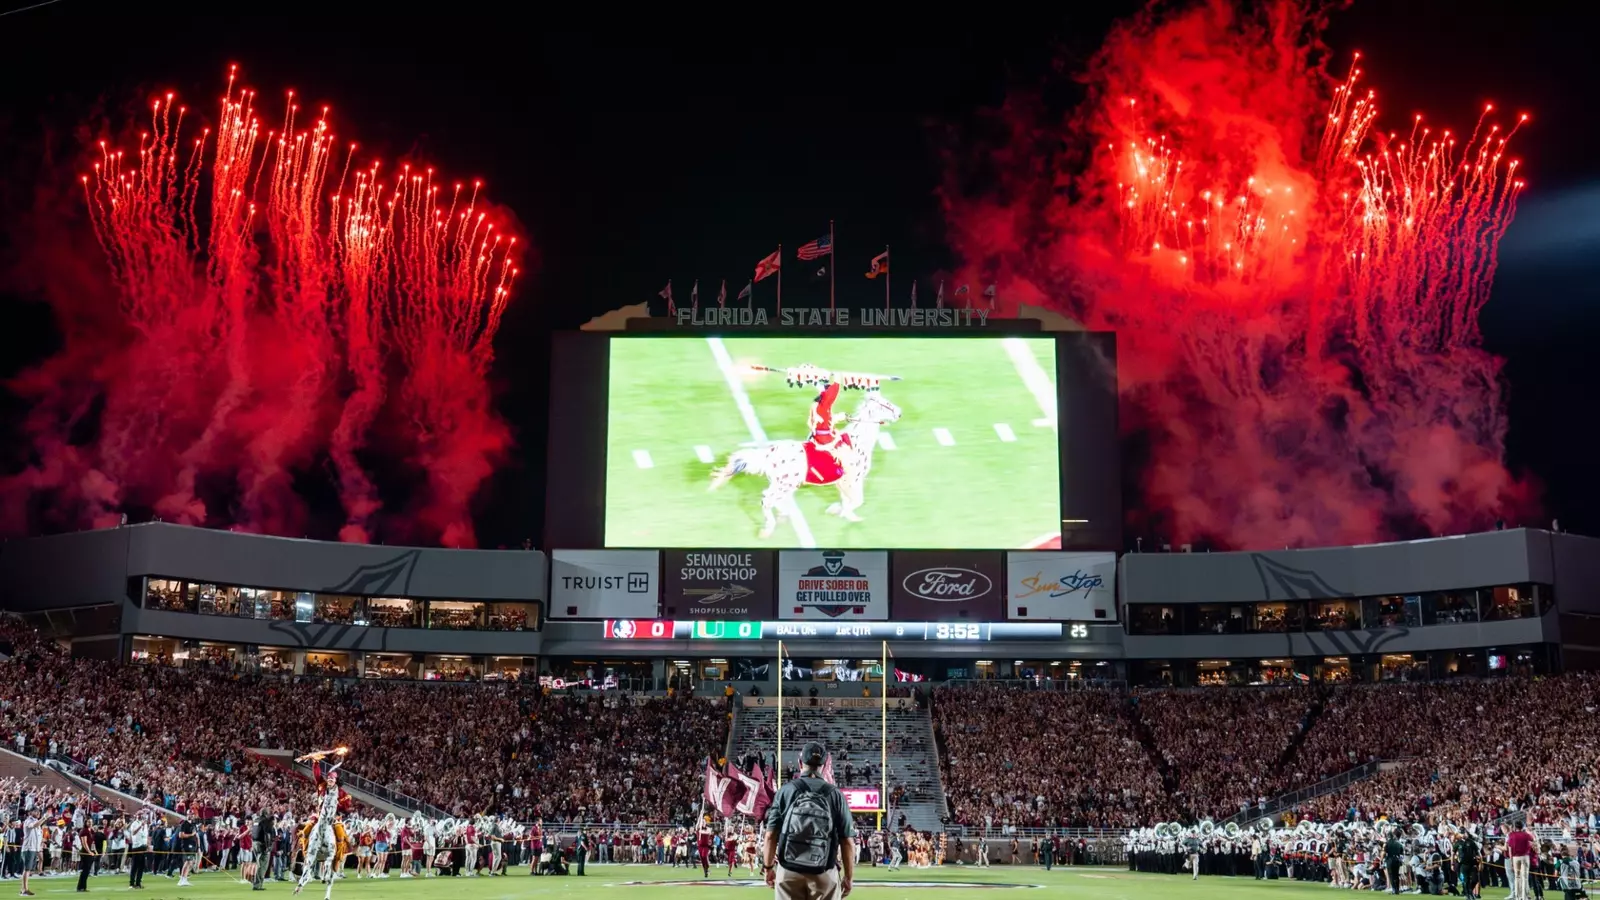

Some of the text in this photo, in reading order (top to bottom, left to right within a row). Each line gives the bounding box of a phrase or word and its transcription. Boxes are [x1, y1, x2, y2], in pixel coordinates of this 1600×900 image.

[677, 308, 990, 326] FLORIDA STATE UNIVERSITY
[686, 554, 752, 567] SEMINOLE
[680, 568, 757, 580] SPORTSHOP
[562, 576, 624, 589] TRUIST
[798, 580, 869, 590] DRIVE SOBER OR
[918, 571, 976, 595] Ford
[1014, 570, 1102, 599] Sun Stop
[796, 591, 871, 602] GET PULLED OVER
[651, 622, 665, 637] 0
[739, 622, 752, 637] 0
[776, 624, 799, 635] BALL
[852, 625, 871, 636] QTR
[1071, 624, 1088, 638] 25
